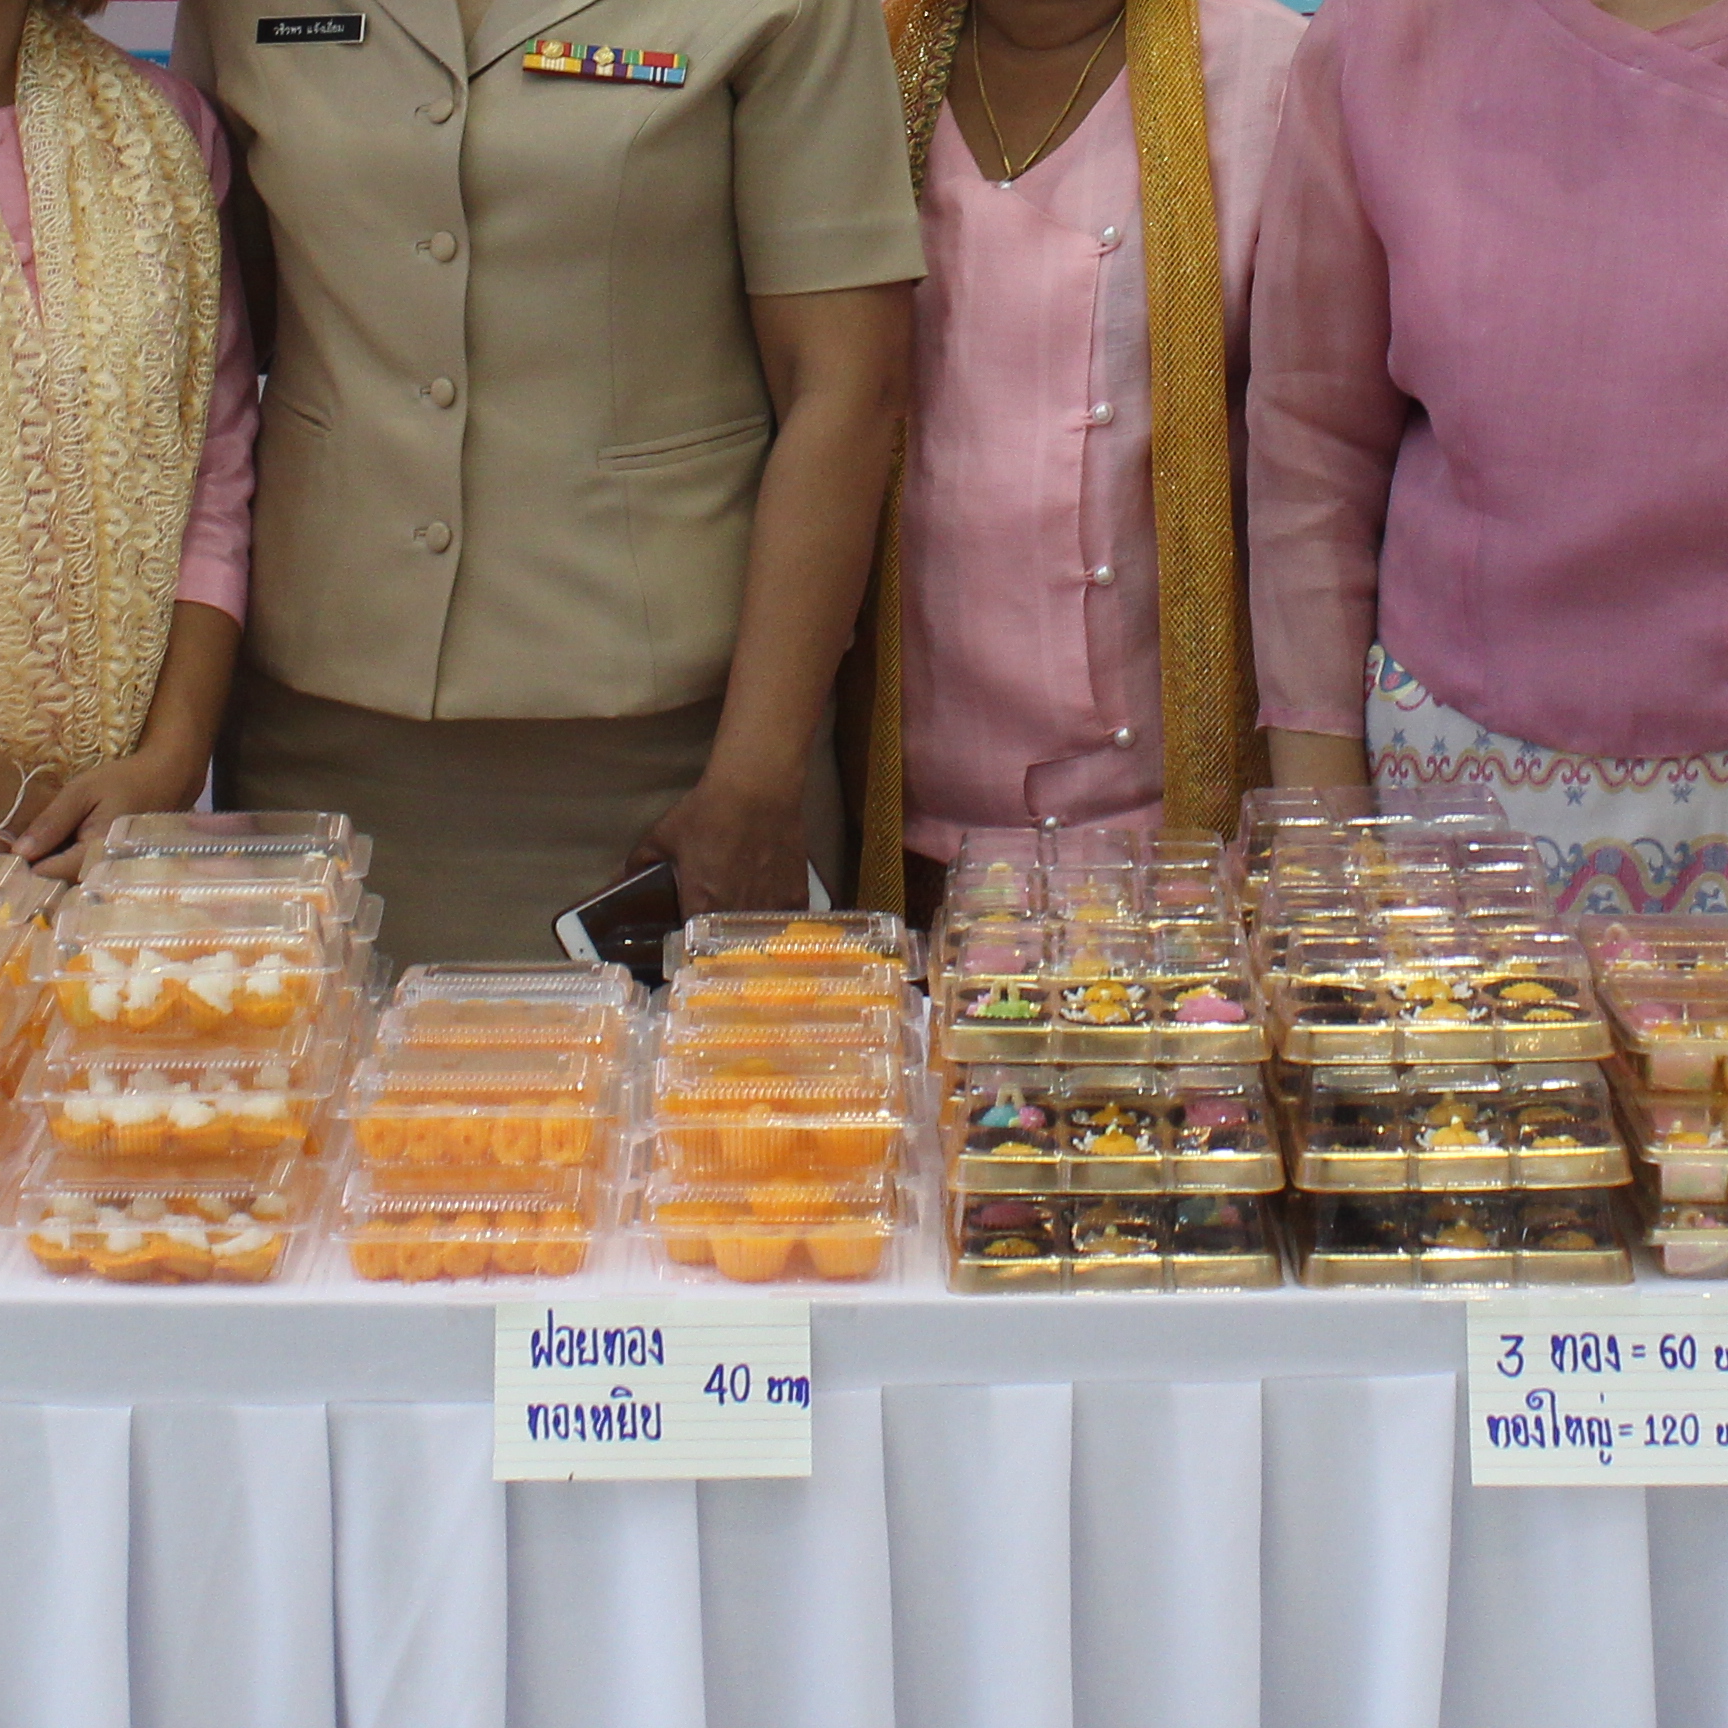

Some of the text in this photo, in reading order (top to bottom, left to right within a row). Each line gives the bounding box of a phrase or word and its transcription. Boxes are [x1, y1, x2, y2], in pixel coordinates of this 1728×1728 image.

[531, 1308, 664, 1369] ฝอยทอง
[1497, 1334, 1525, 1378] 3
[1550, 1332, 1622, 1373] ทอง
[1659, 1333, 1697, 1371] 60
[704, 1363, 751, 1405] 40
[527, 1386, 662, 1442] ทองหยิบ
[1486, 1388, 1613, 1465] ทองใหญ่
[1643, 1413, 1700, 1446] 120
